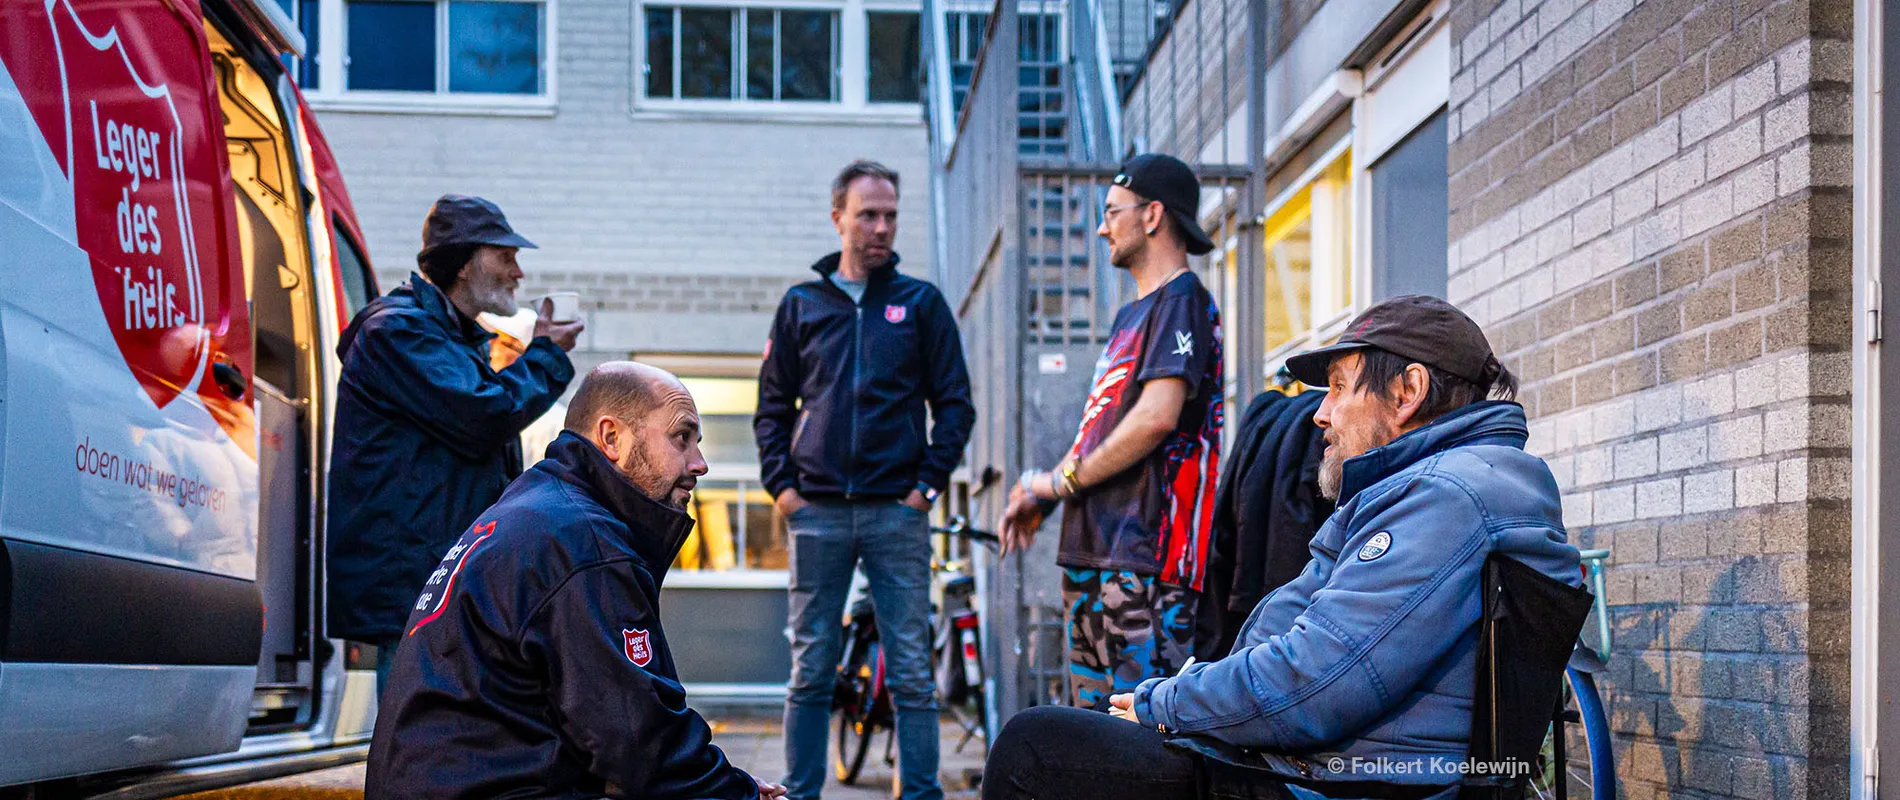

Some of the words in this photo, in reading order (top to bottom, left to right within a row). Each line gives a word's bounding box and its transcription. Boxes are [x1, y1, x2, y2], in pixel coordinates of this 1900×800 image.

[90, 99, 160, 192] Leger
[117, 187, 161, 255] des
[75, 435, 120, 481] doen
[124, 458, 152, 492] wat
[156, 469, 177, 498] we
[178, 475, 227, 512] geloven
[628, 635, 645, 646] Leger
[632, 643, 644, 652] des
[632, 650, 648, 661] Heils
